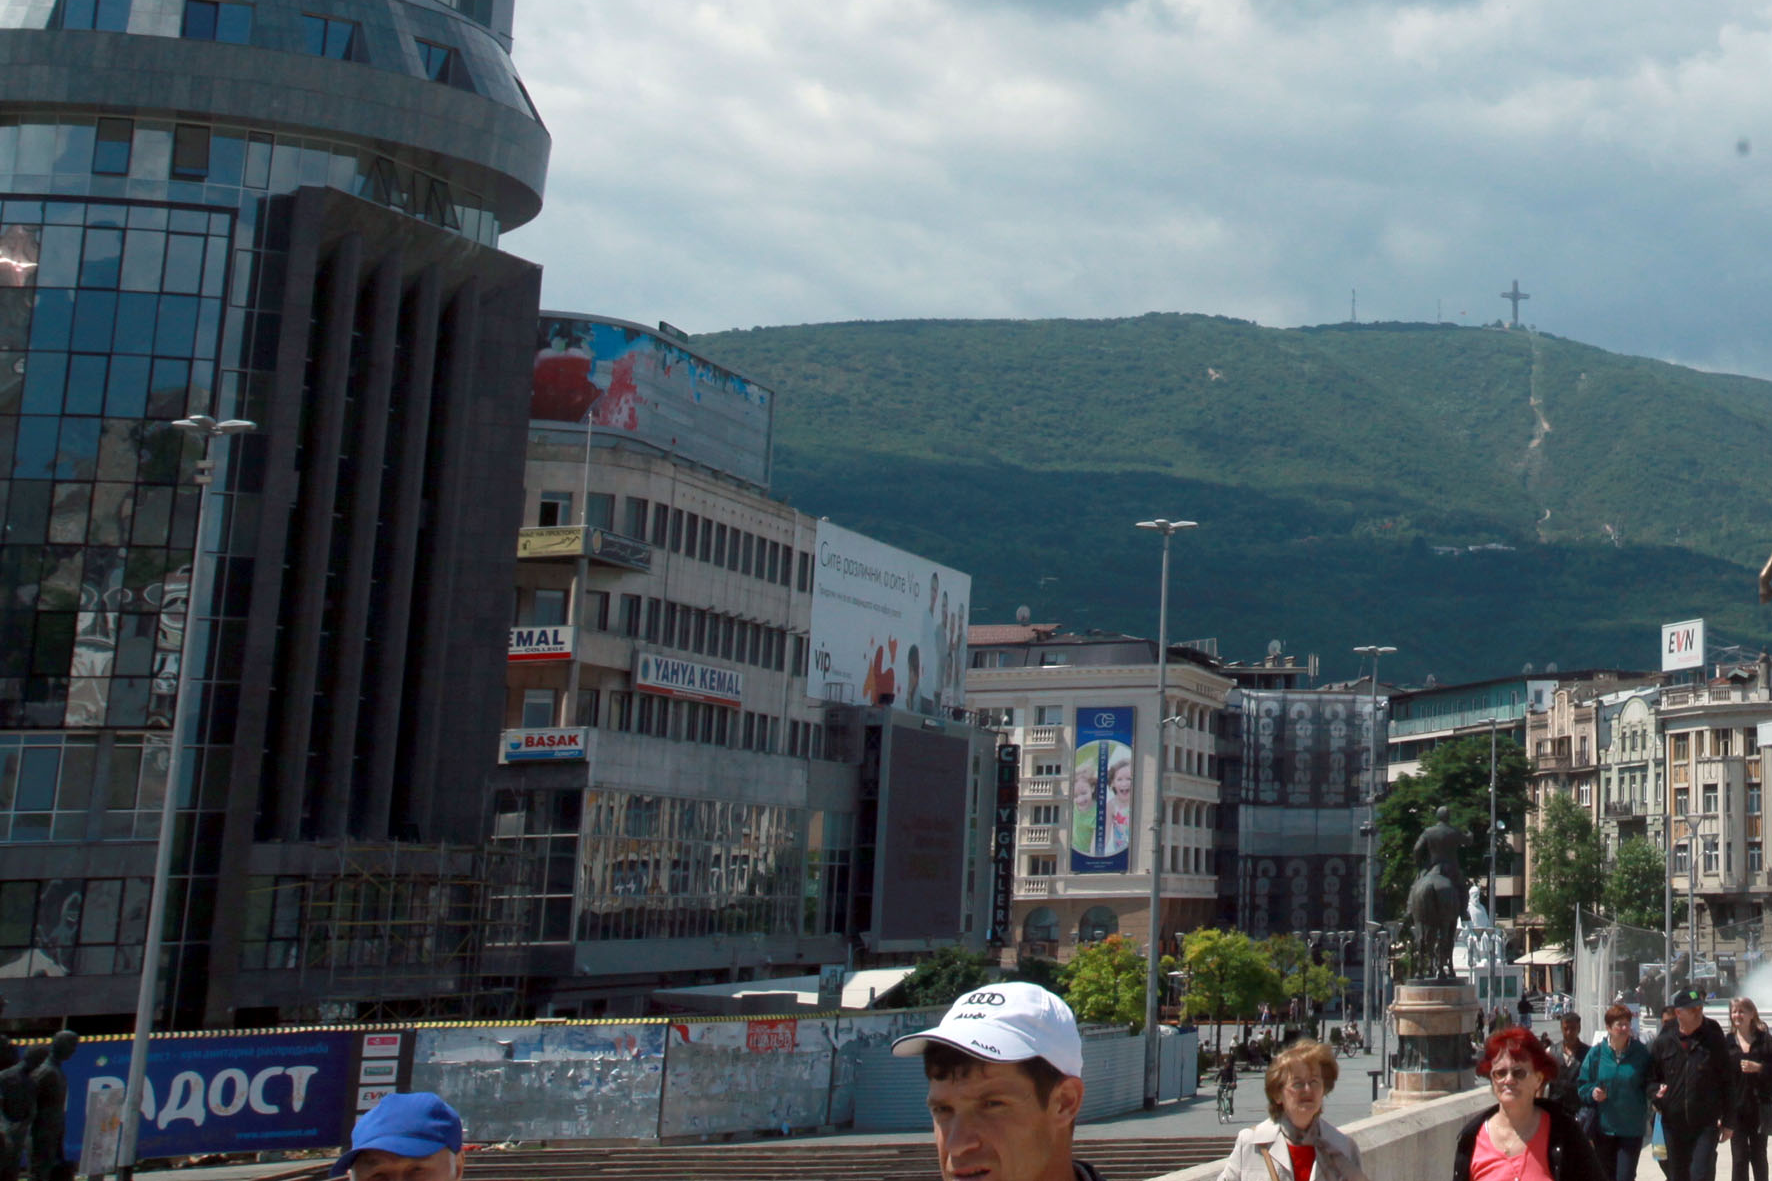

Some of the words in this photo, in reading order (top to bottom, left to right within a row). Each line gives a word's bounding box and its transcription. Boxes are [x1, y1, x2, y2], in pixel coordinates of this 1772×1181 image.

[820, 541, 841, 571] Сите
[1668, 628, 1695, 654] EVN
[655, 658, 696, 688] YAHYA
[700, 667, 741, 695] KEMAL
[815, 641, 831, 680] vip
[525, 734, 579, 747] BASAK
[995, 831, 1010, 936] GALLERY
